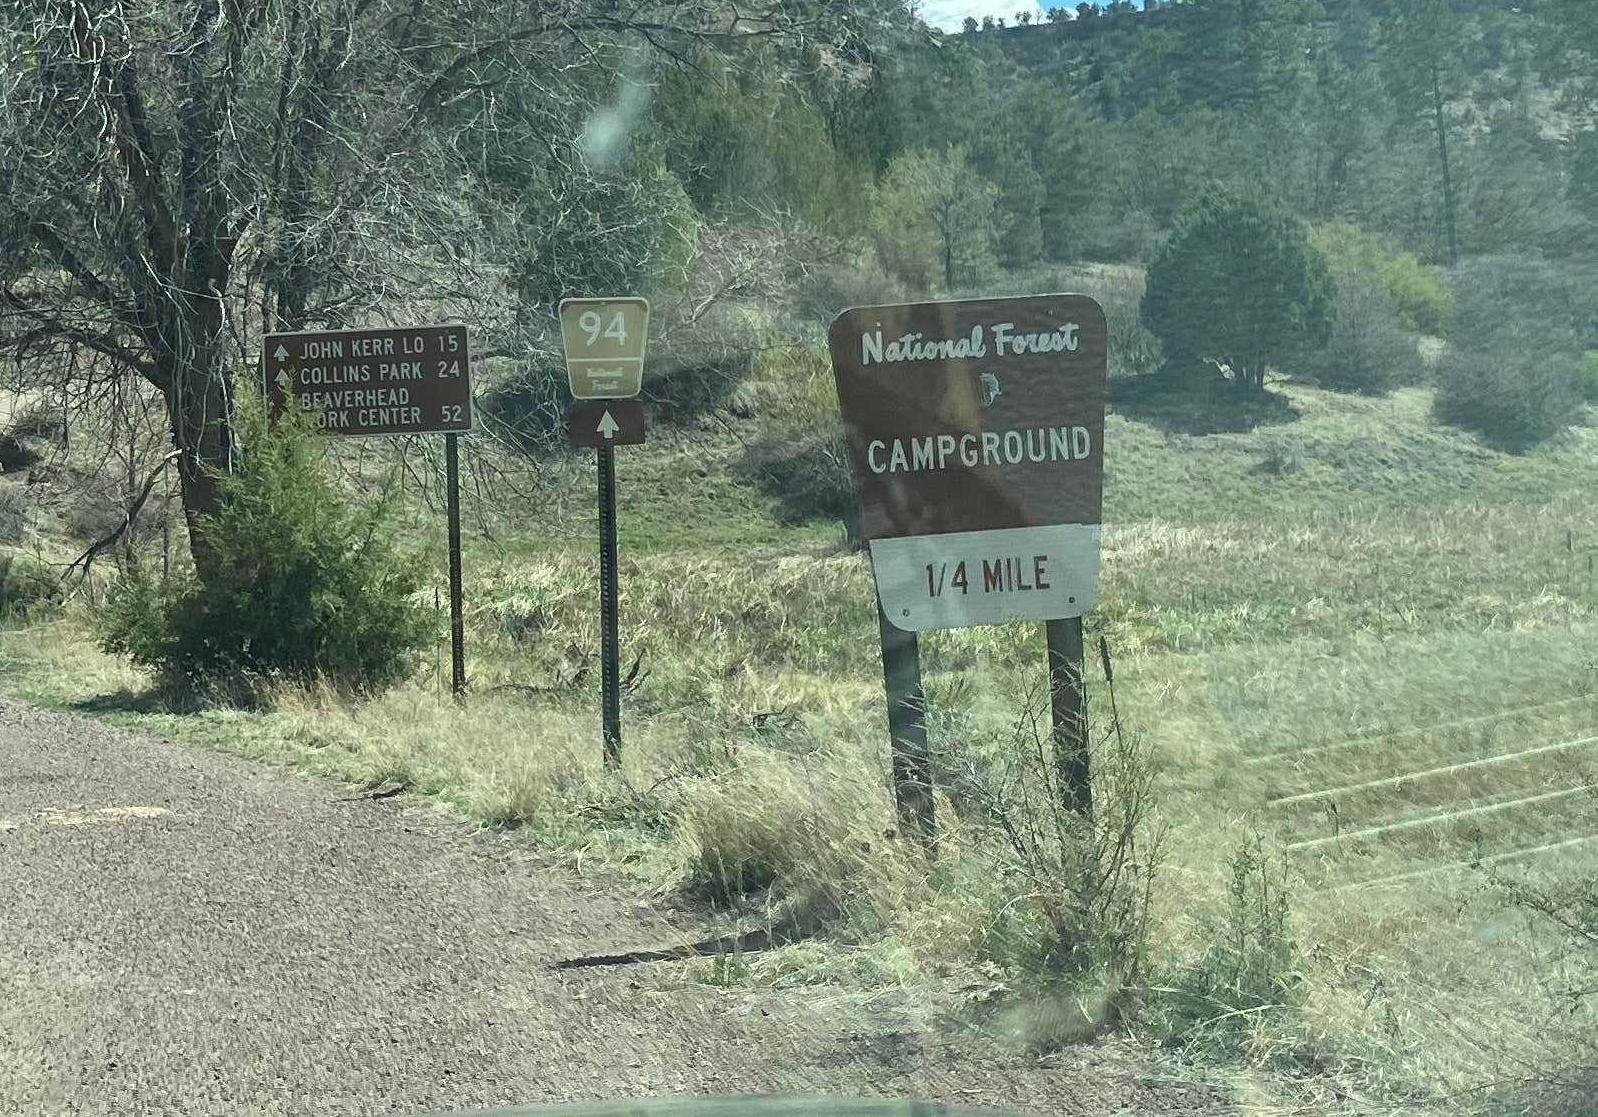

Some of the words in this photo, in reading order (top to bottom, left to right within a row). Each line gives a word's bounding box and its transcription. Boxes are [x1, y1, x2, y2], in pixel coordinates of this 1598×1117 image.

[580, 311, 627, 346] 94
[862, 323, 986, 365] National
[991, 322, 1079, 356] Forest
[300, 340, 343, 360] JOHN
[352, 338, 394, 357] KERR
[403, 336, 424, 354] LO
[438, 335, 458, 352] 15
[300, 364, 371, 384] COLLINS
[380, 362, 422, 380] PARK
[438, 360, 460, 378] 24
[301, 388, 409, 409] BEAVERHEAD
[317, 411, 350, 429] ORK
[358, 407, 421, 426] CENTER
[441, 405, 462, 422] 52
[868, 426, 1091, 474] CAMPGROUND
[926, 561, 968, 597] 1/4
[983, 556, 1051, 593] MILE
